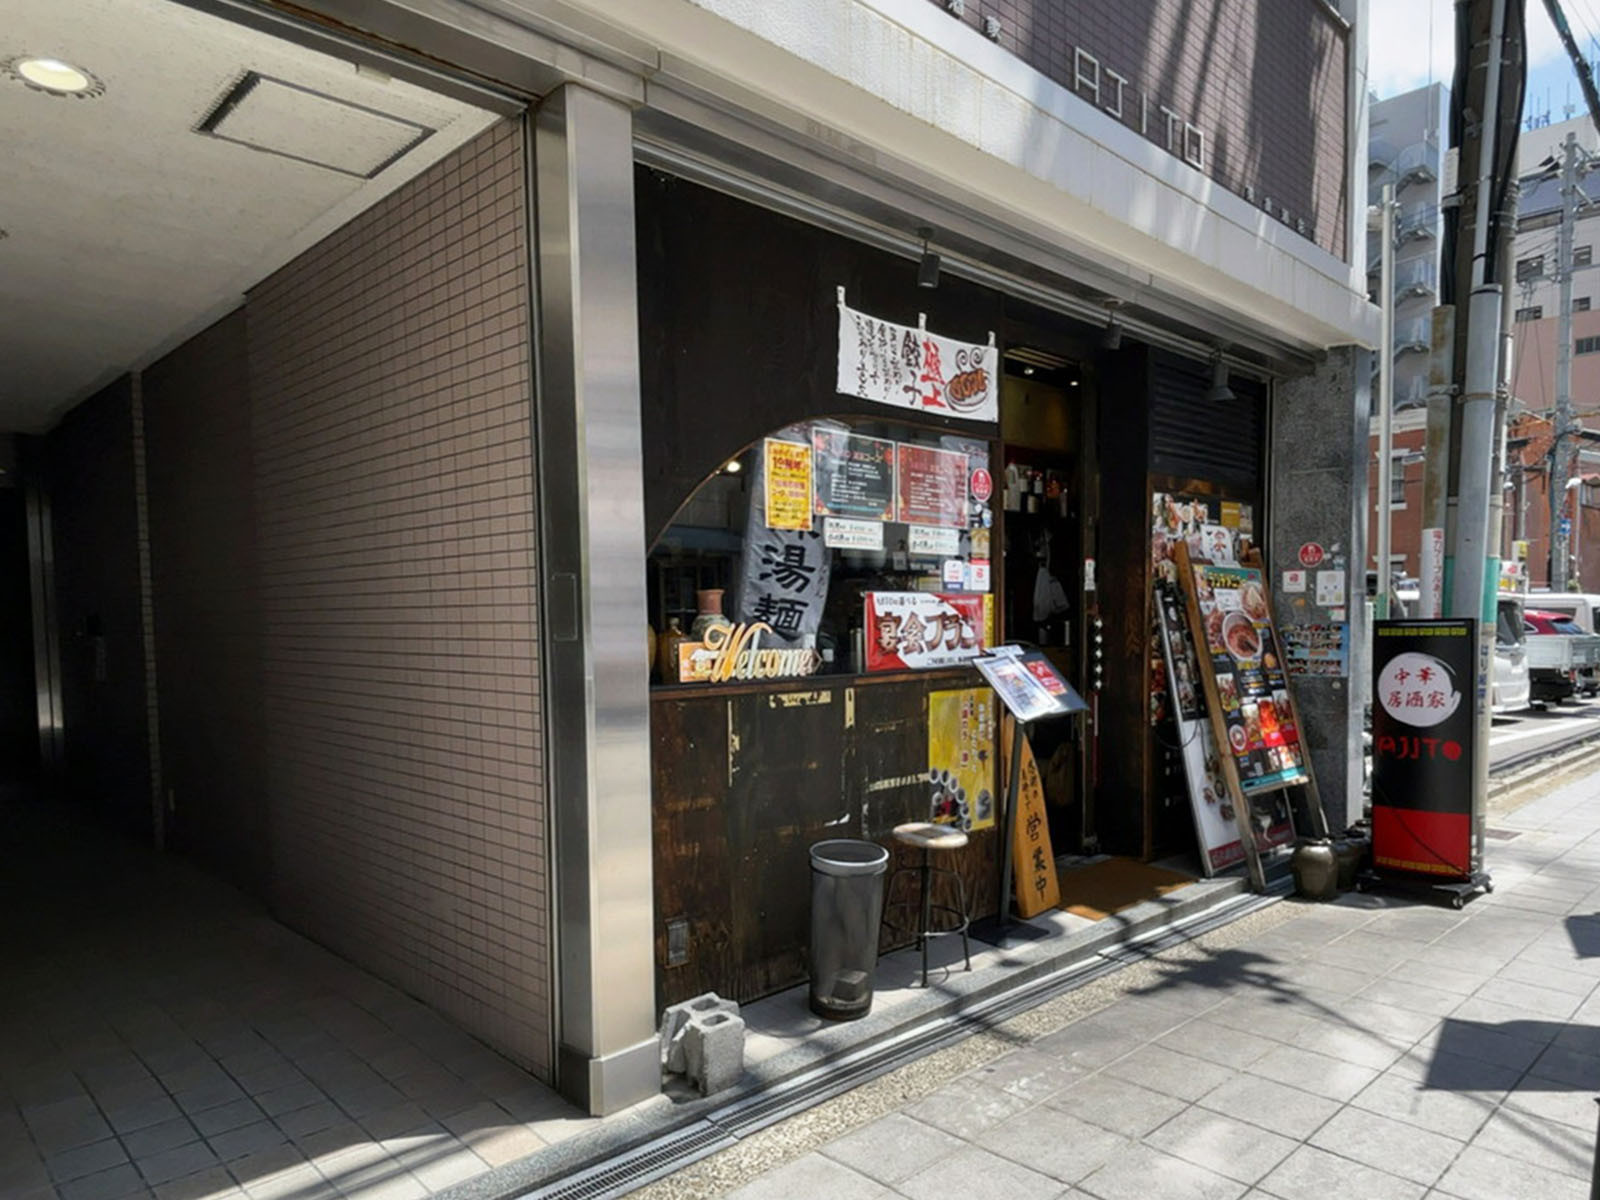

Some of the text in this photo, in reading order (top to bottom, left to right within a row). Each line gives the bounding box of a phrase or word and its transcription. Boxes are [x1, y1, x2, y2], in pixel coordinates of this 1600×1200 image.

[1074, 46, 1204, 169] AJITO
[901, 329, 923, 406] 餃子
[704, 622, 815, 683] Welcome
[875, 611, 979, 655] 宴会プラン
[1387, 690, 1446, 709] 居酒家
[1394, 666, 1437, 686] 中華
